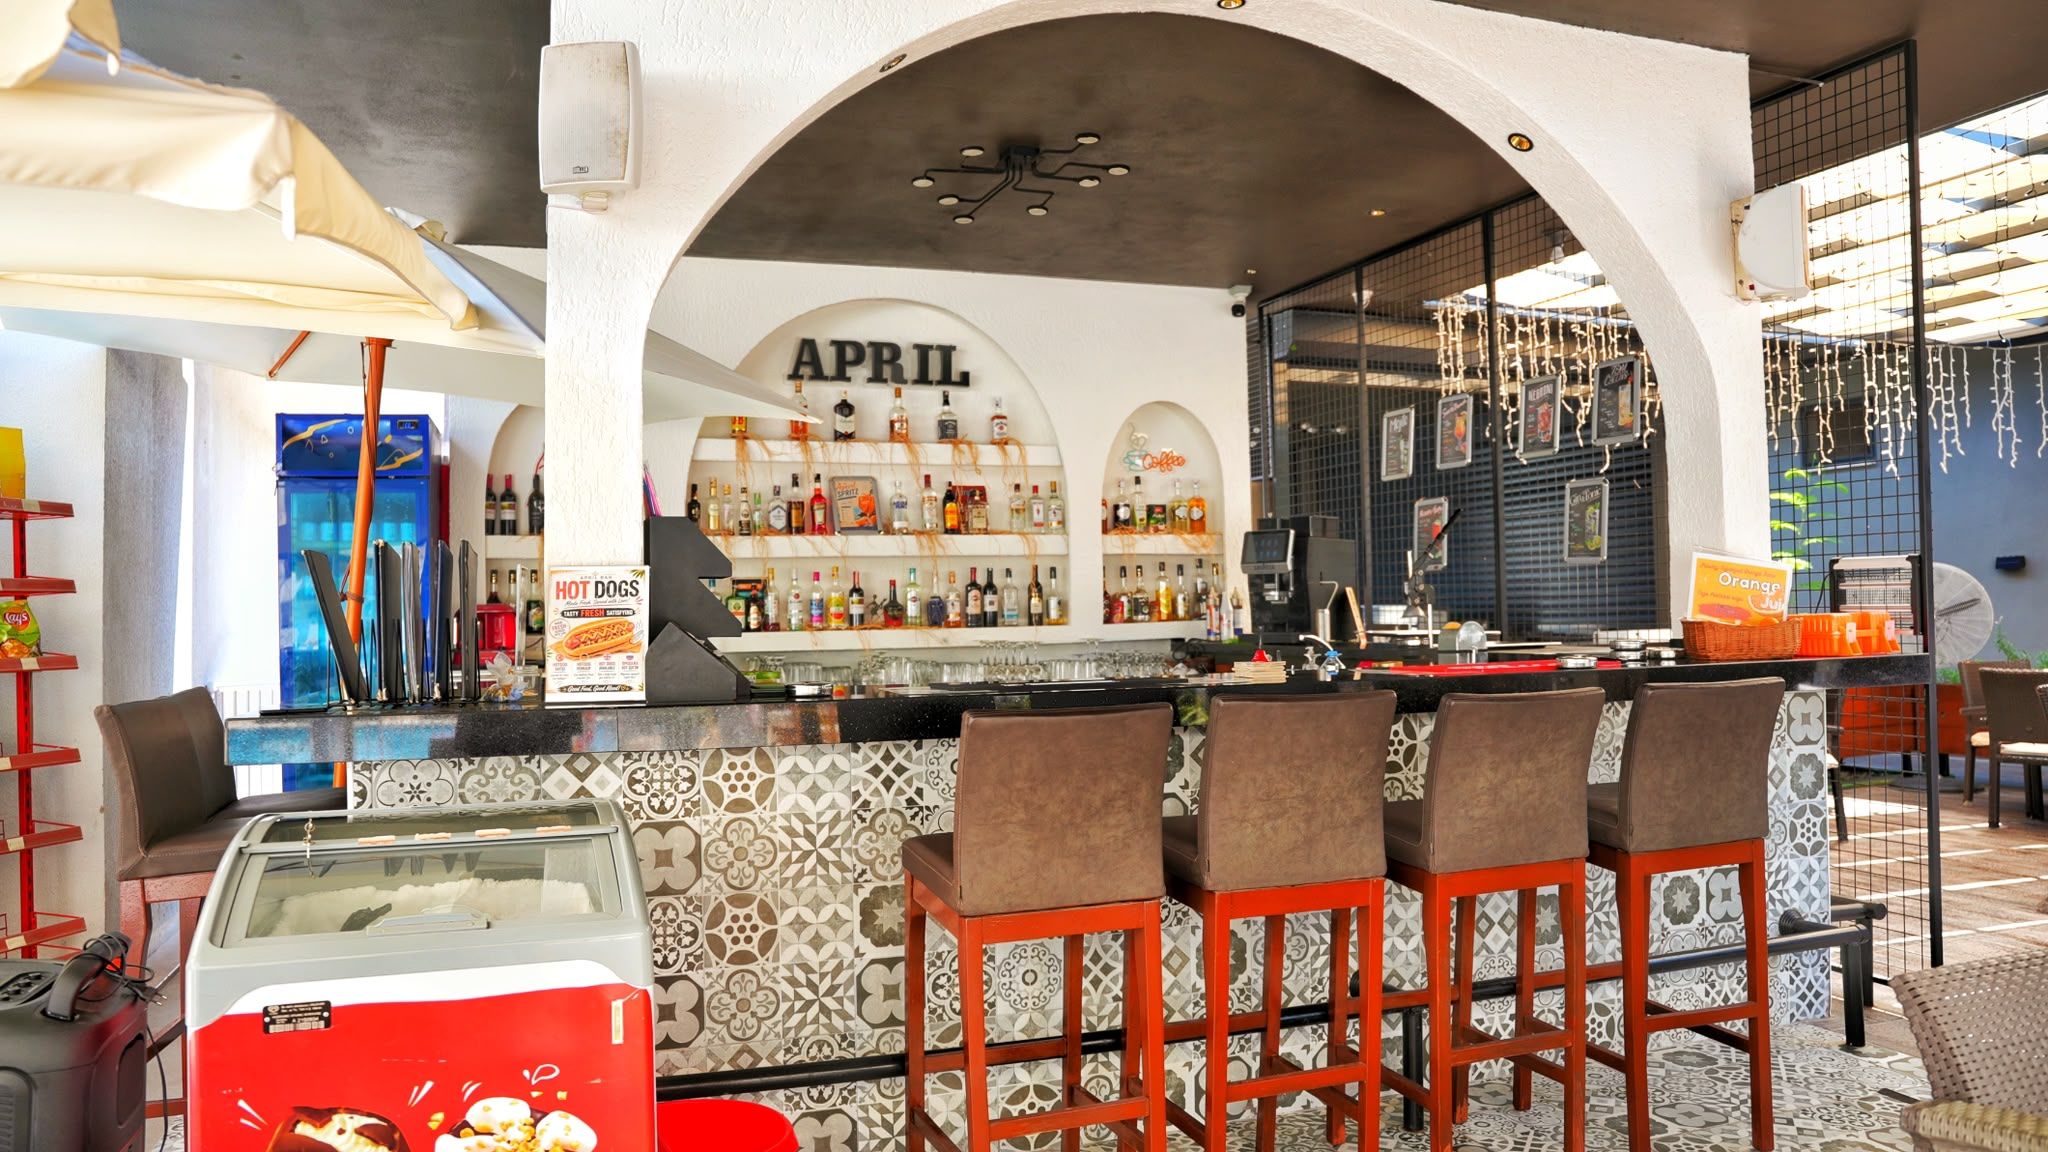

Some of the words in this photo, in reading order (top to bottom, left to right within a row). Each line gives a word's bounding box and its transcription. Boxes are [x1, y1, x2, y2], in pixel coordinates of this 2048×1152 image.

[787, 338, 970, 387] APRIL
[1143, 451, 1186, 473] Coffee
[555, 581, 590, 600] HOT
[594, 580, 639, 598] DOGS
[1718, 571, 1781, 595] Orange
[580, 608, 605, 617] FRESH
